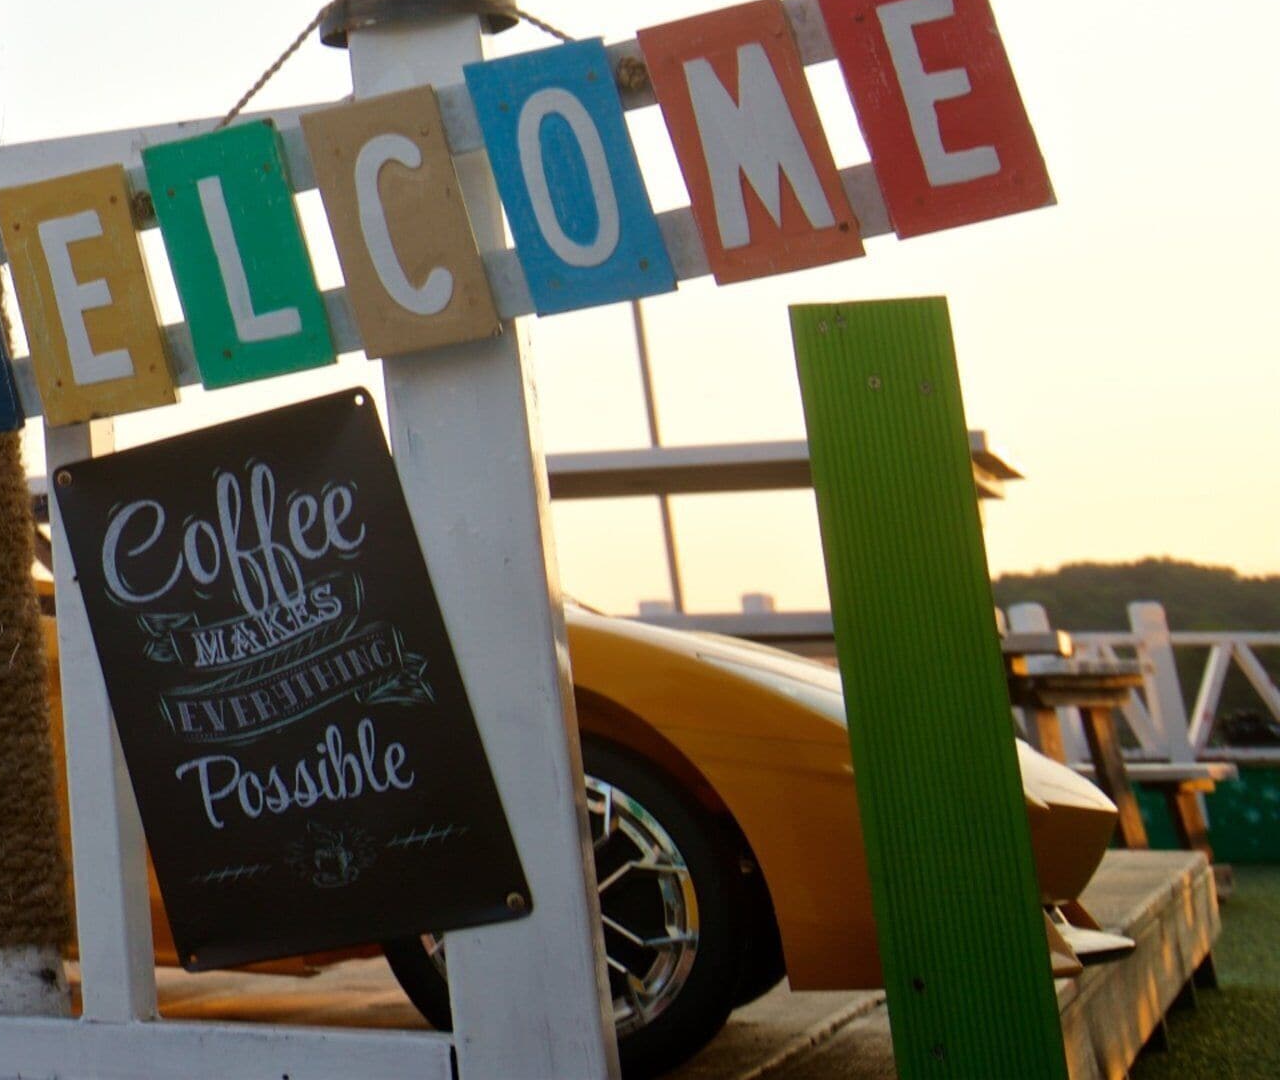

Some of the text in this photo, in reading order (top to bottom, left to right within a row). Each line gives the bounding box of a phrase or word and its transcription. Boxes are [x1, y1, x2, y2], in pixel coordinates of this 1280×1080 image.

[102, 461, 366, 616] Coffee
[191, 582, 342, 668] MAKES
[176, 638, 393, 733] EVERYTHING
[176, 718, 415, 829] Possible
